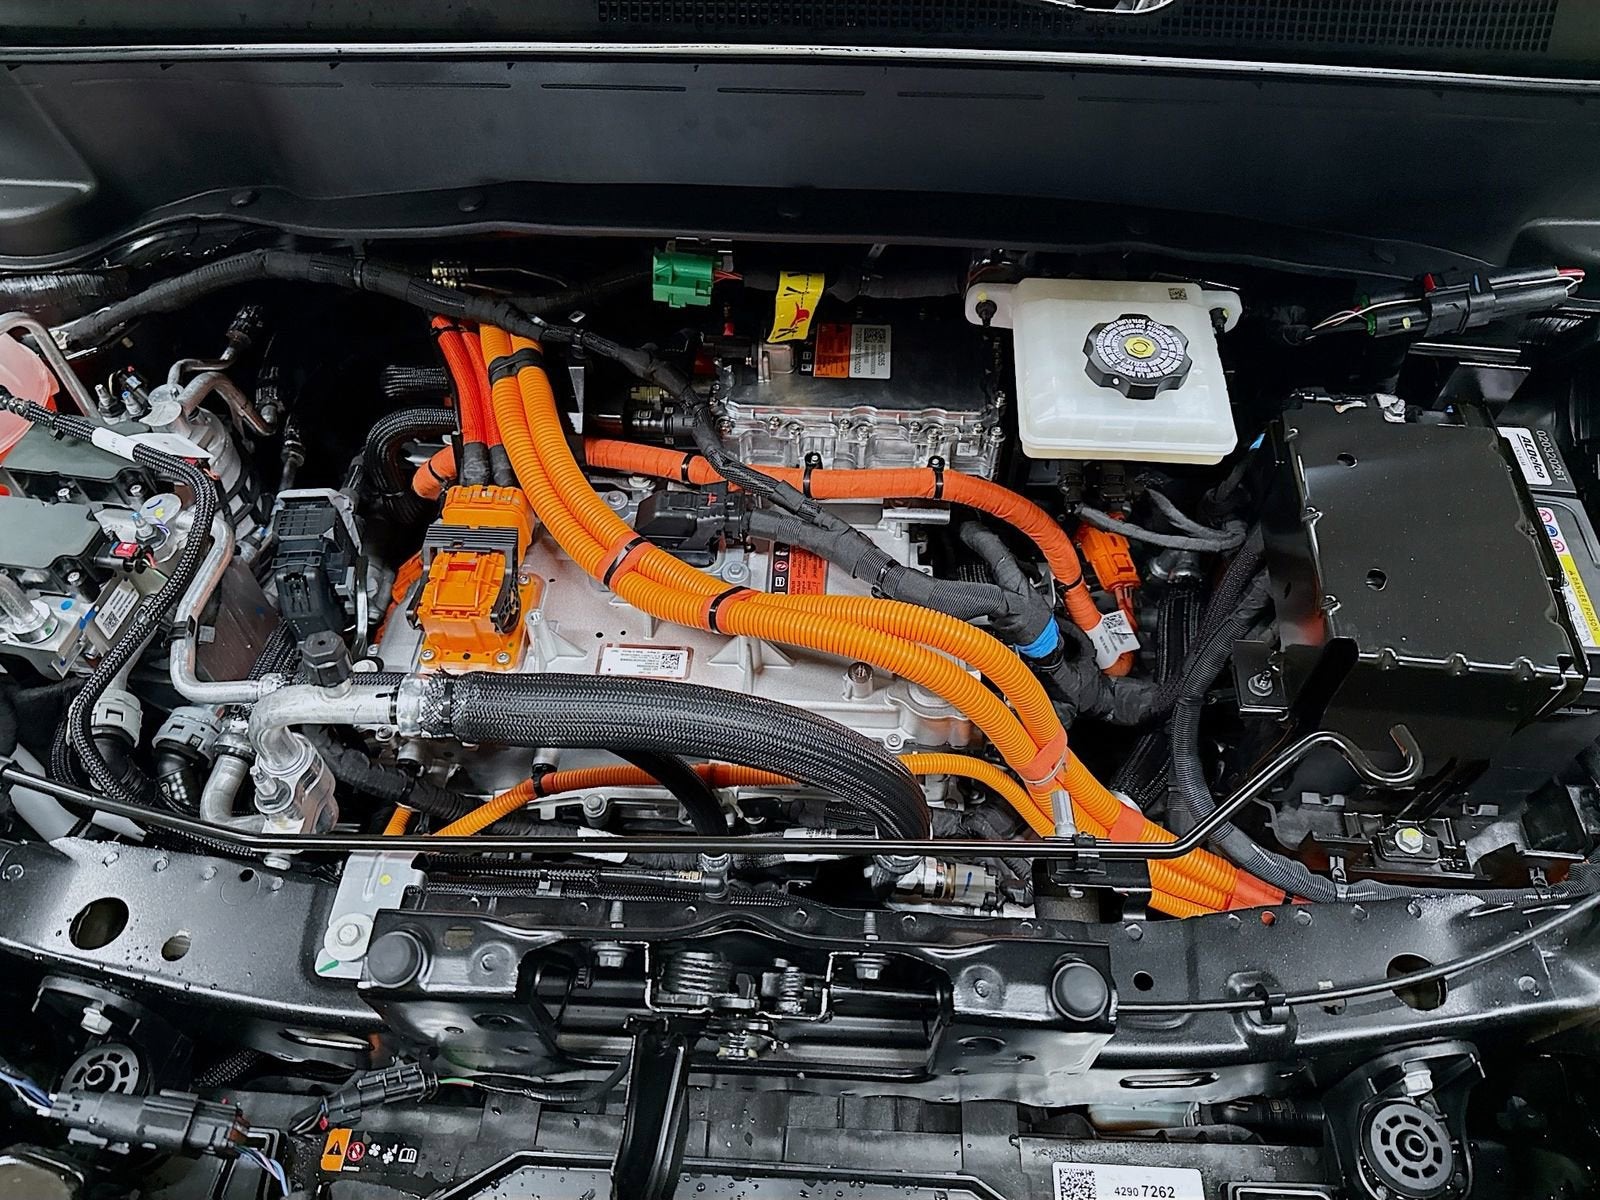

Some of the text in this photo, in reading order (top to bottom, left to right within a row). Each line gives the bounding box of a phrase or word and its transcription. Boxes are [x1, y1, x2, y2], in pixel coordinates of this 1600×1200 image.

[1520, 435, 1546, 479] ACDelco
[1536, 430, 1569, 483] 02032026T
[1114, 1184, 1176, 1199] 4290 7262
